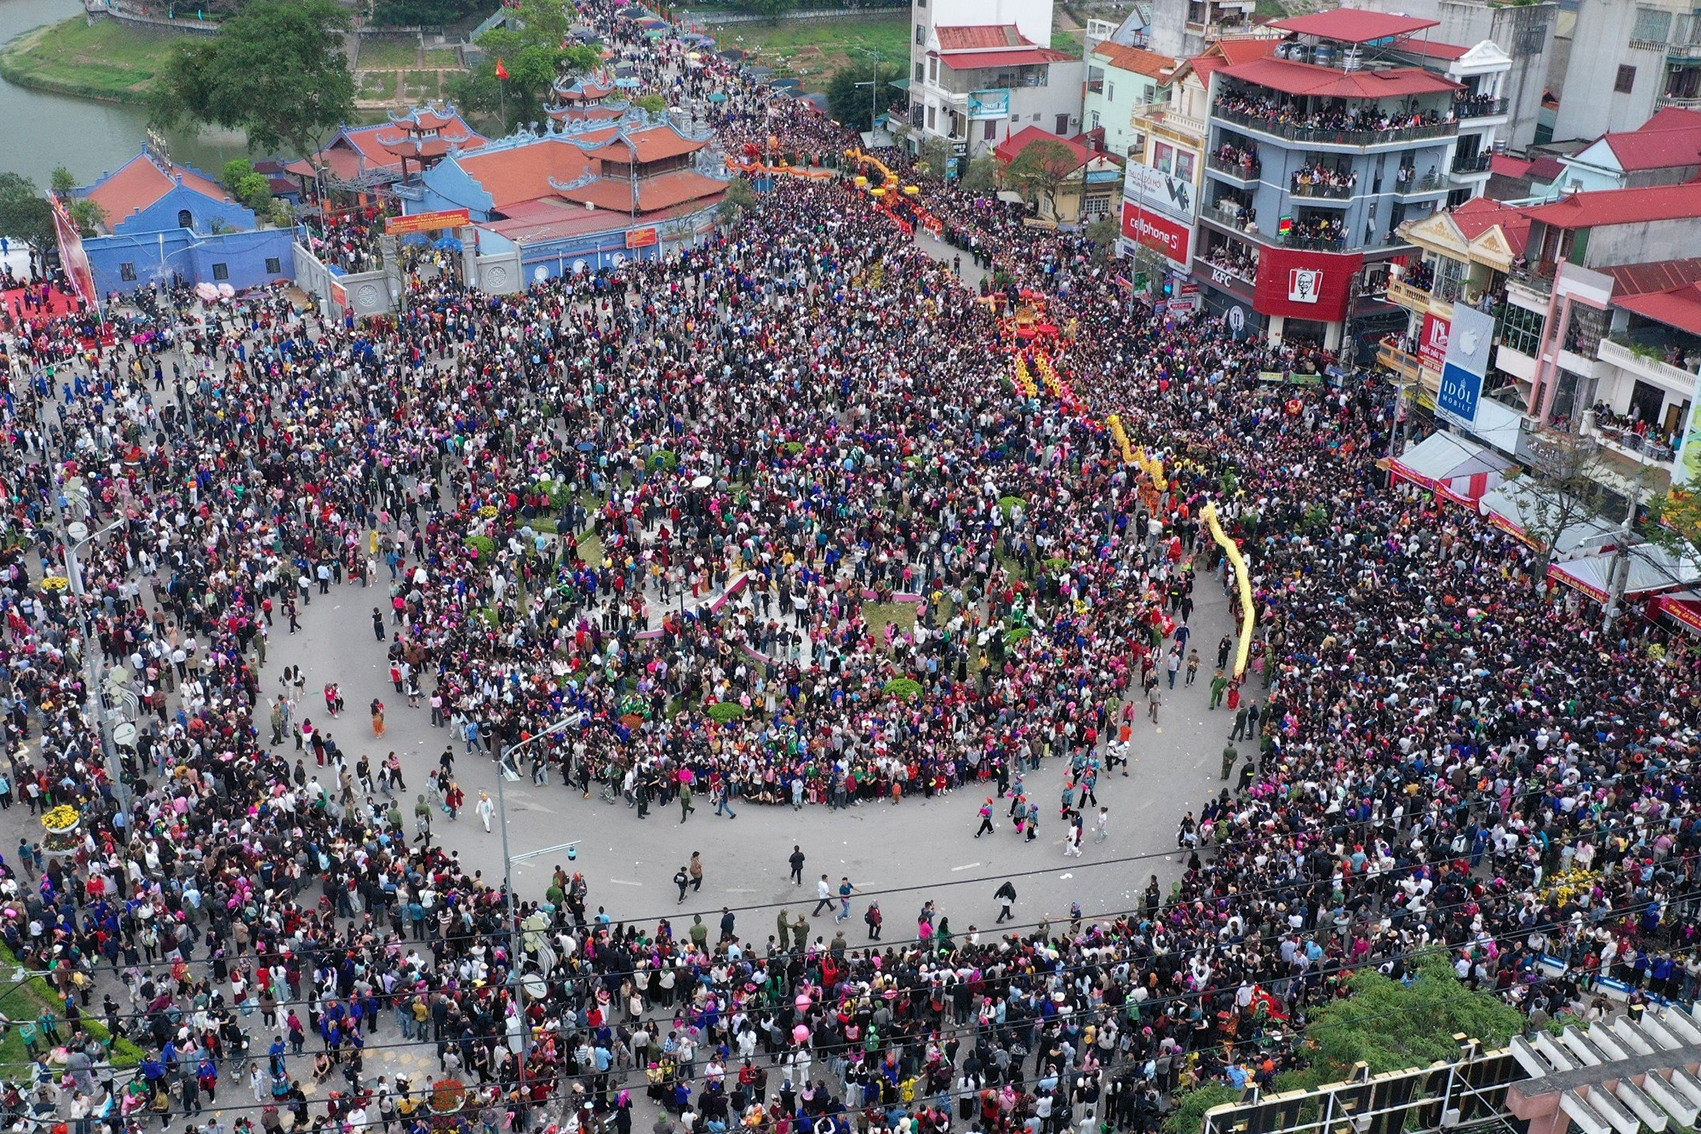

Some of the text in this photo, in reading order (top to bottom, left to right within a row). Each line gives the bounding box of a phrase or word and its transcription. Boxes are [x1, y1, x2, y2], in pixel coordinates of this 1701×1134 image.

[1211, 269, 1232, 288] KFC
[1443, 380, 1472, 404] IDOL
[1442, 394, 1471, 413] MOBILE
